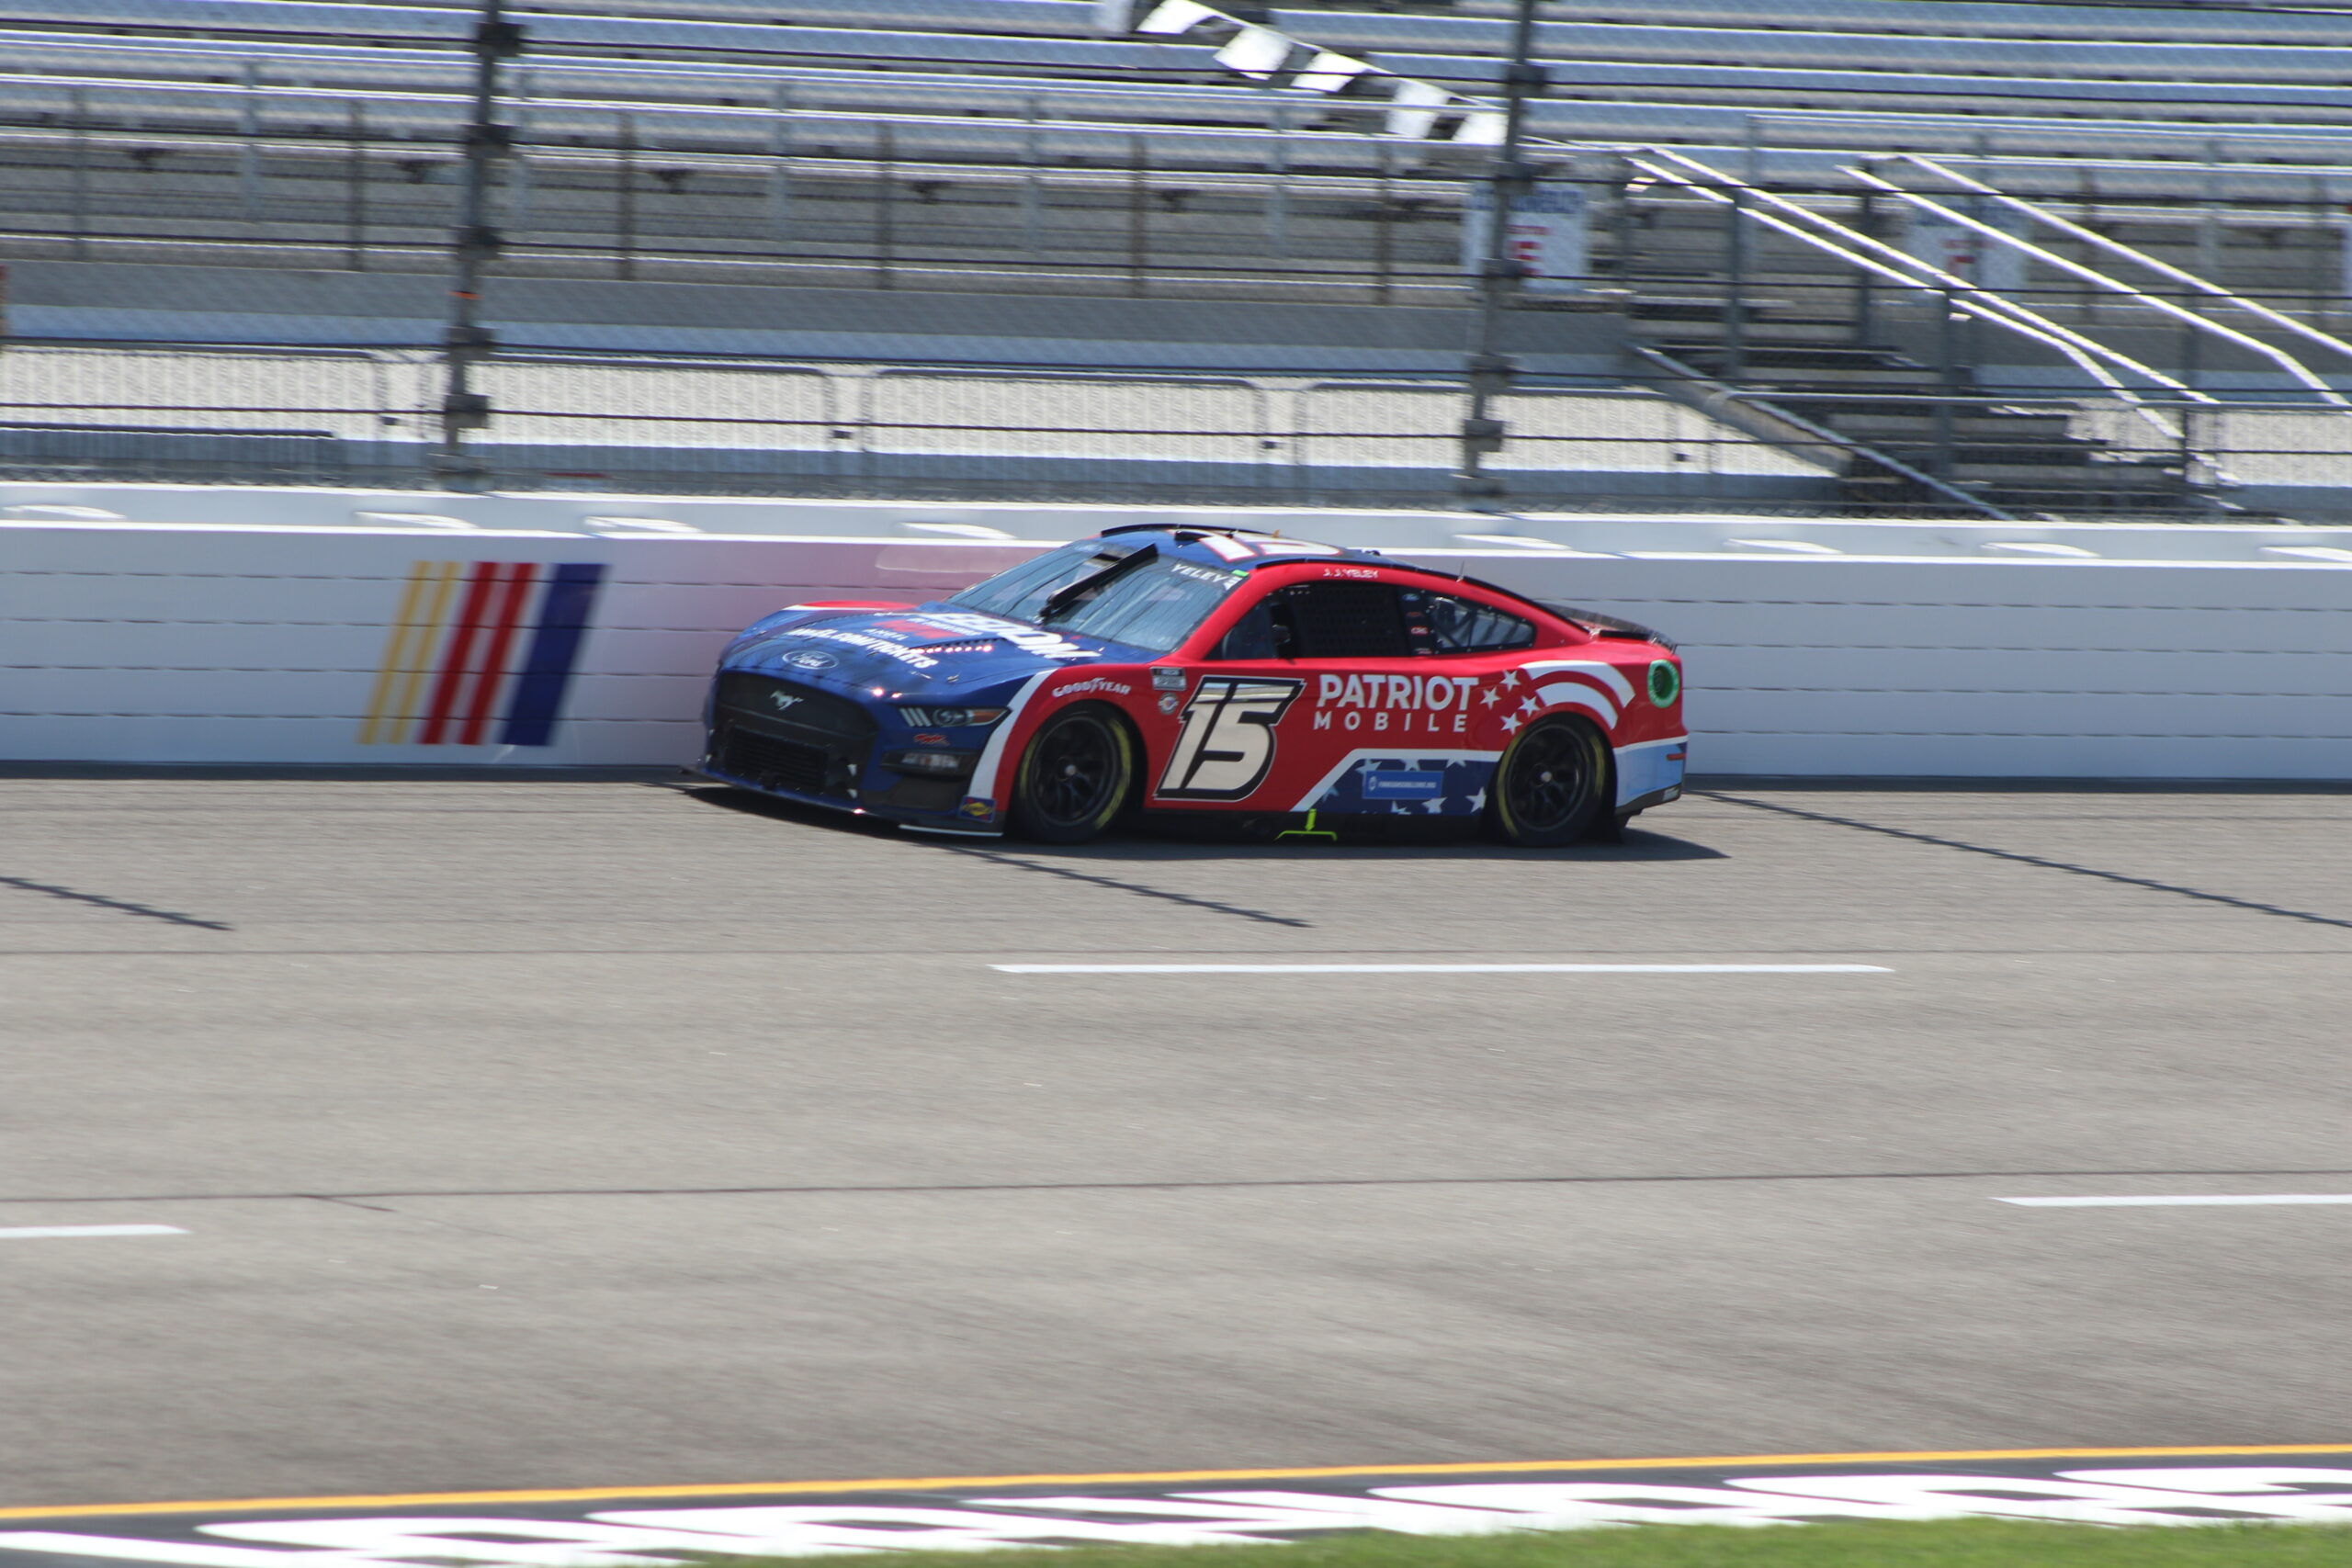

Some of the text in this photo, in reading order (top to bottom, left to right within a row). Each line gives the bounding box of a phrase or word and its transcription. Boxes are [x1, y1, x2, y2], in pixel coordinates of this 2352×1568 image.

[1052, 677, 1132, 698] GOODYEAR
[1316, 674, 1479, 711] PATRIOT
[1313, 711, 1468, 733] MOBILE
[1155, 676, 1305, 800] 15
